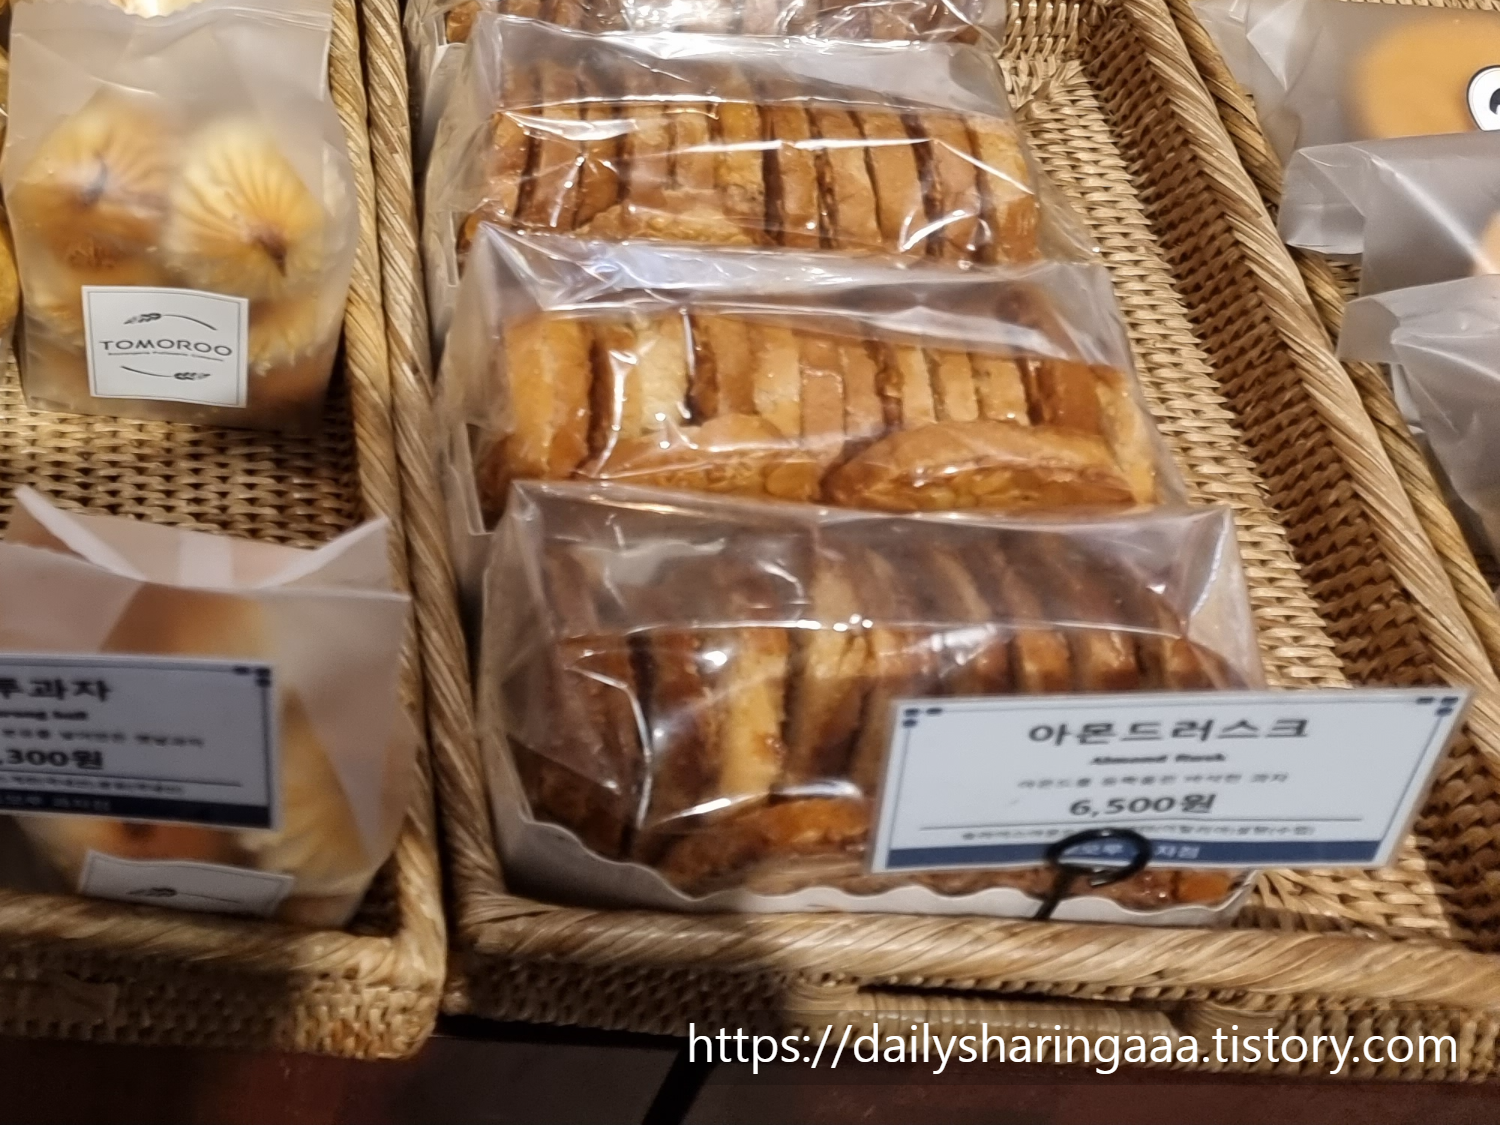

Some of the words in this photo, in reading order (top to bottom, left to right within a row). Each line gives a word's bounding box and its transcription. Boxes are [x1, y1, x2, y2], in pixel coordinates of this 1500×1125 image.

[99, 339, 232, 357] TOMOROO
[1028, 716, 1312, 745] 아몬드러스크
[1068, 793, 1217, 818] 6,500원
